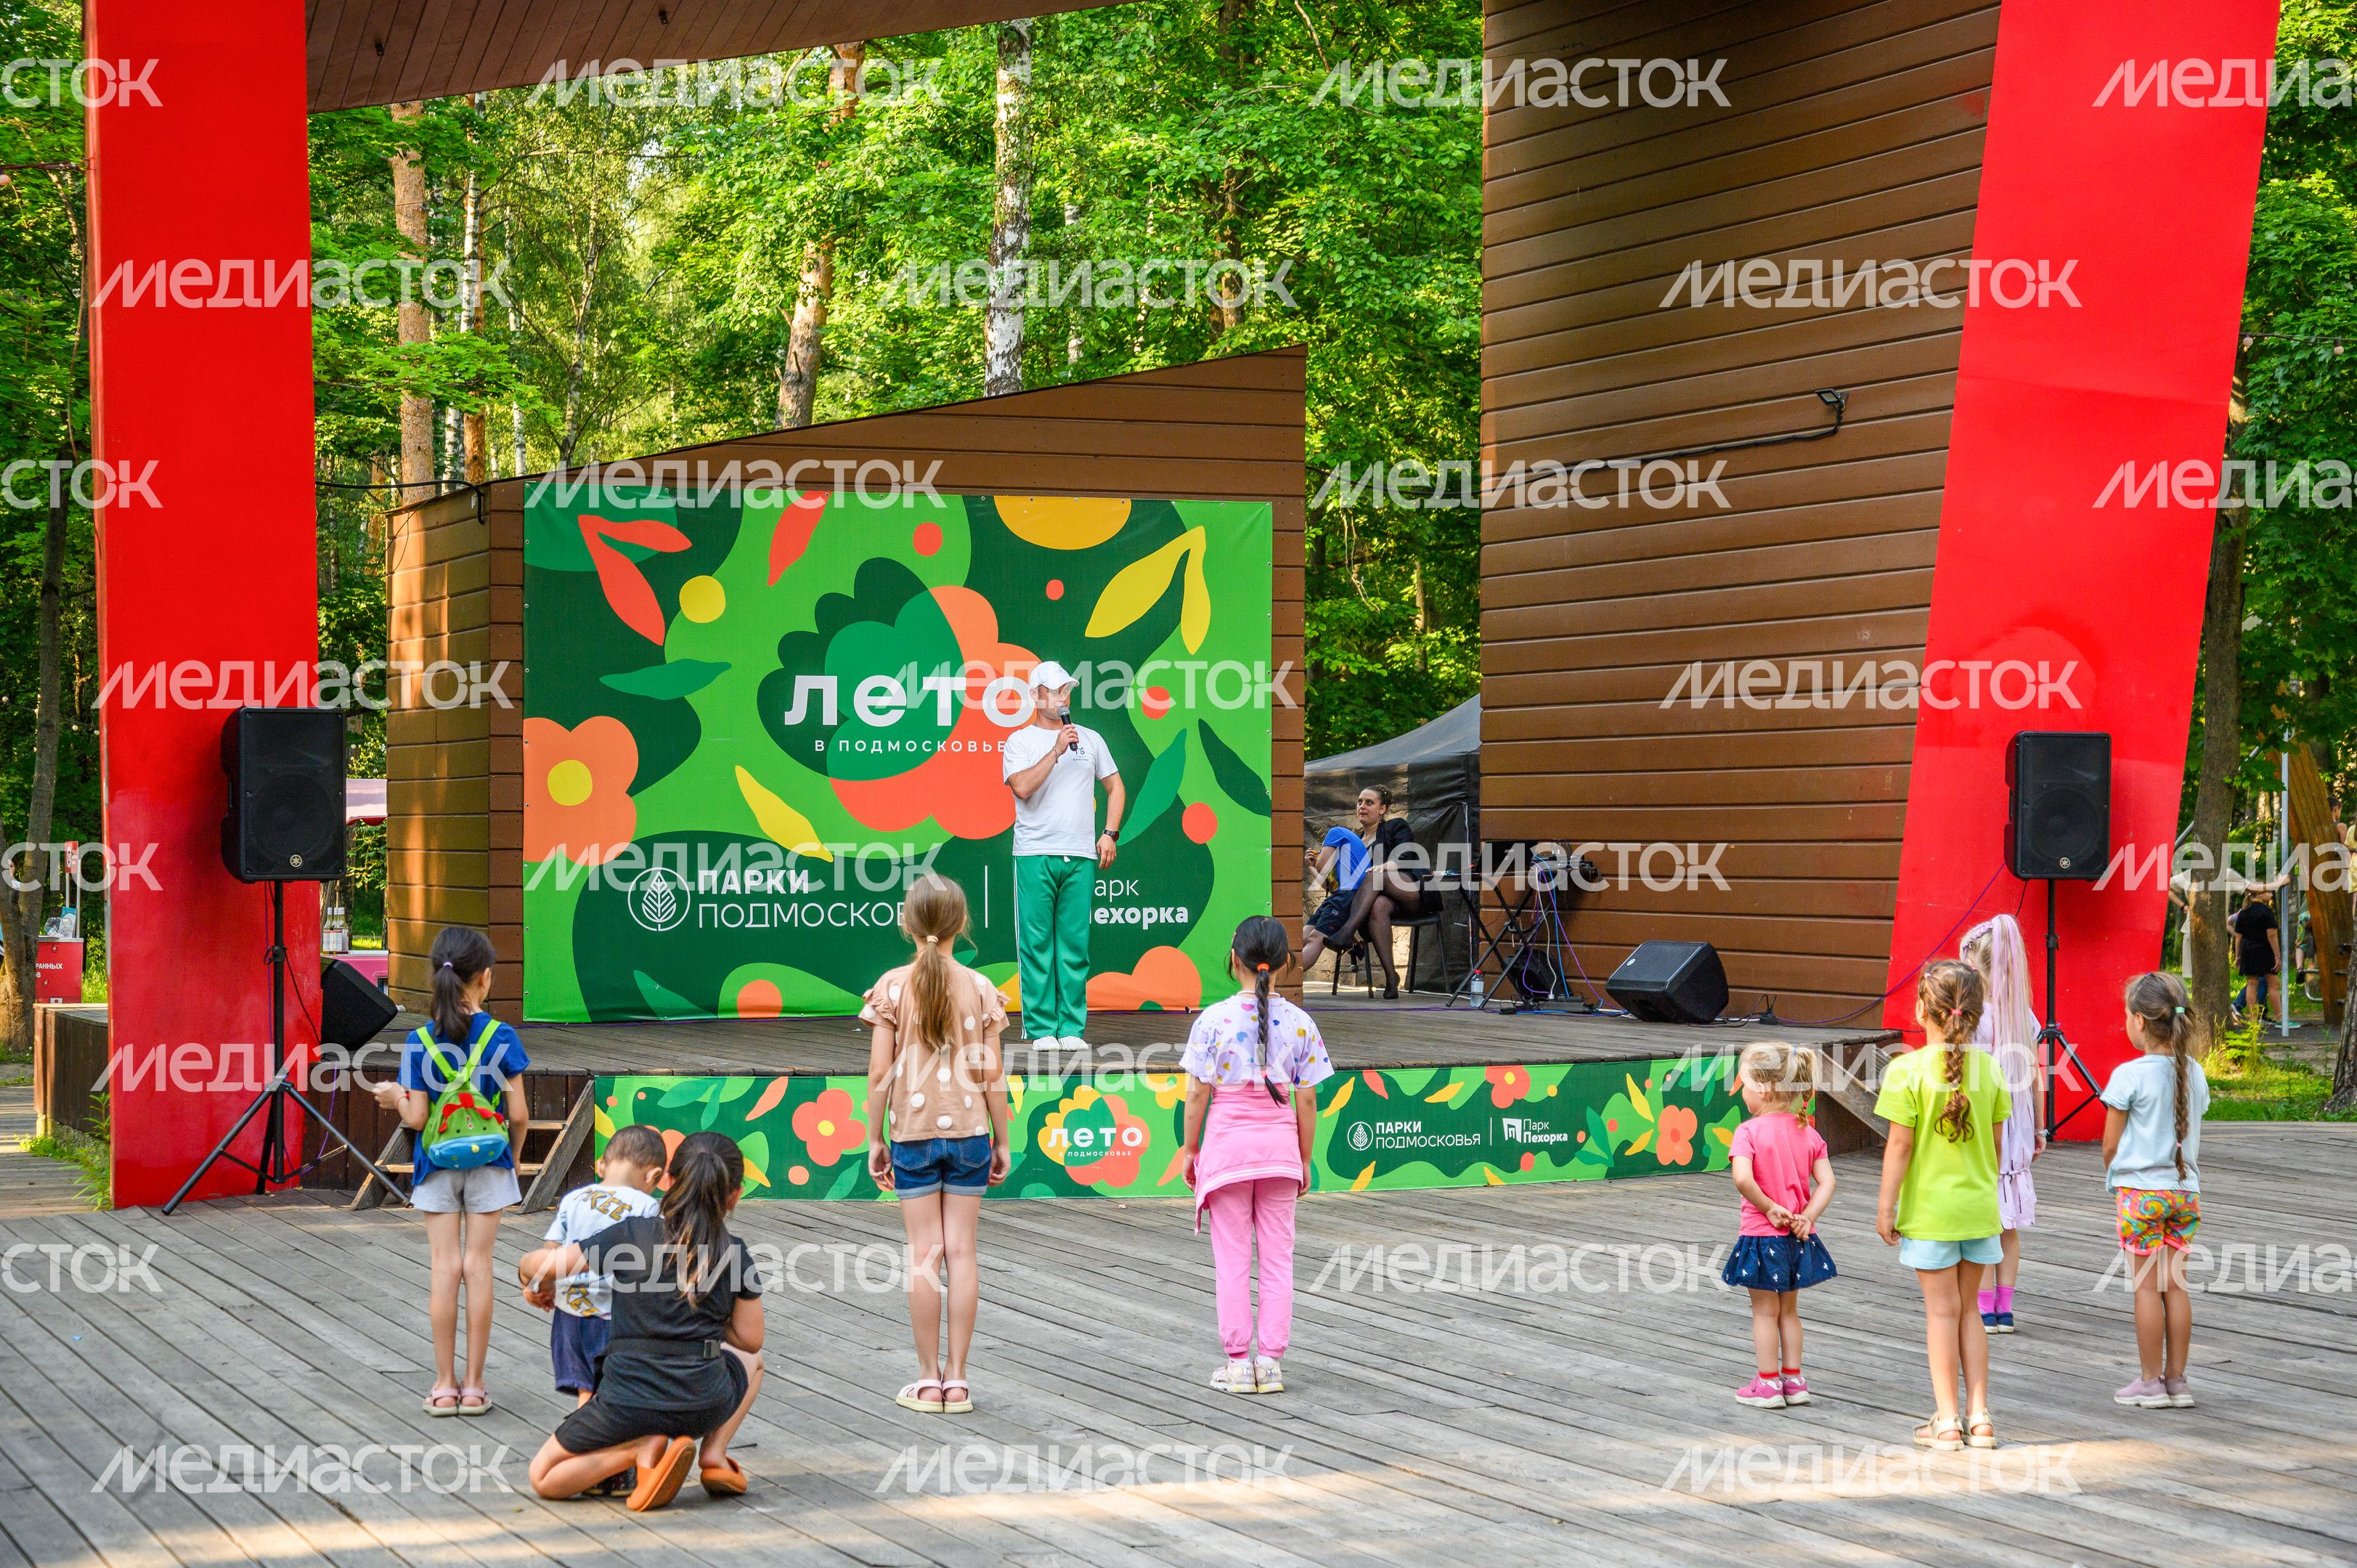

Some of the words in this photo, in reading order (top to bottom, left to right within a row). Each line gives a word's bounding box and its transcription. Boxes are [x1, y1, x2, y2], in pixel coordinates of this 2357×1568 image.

[815, 740, 825, 752] В
[839, 740, 1006, 754] ПОДМОСКОВЬЕ
[699, 869, 809, 894] ПАРКИ
[1094, 878, 1139, 903] арк
[1089, 906, 1189, 930] ехорка
[1376, 1121, 1422, 1134] ПАРКИ
[1523, 1119, 1550, 1132] Парк
[1376, 1133, 1481, 1149] ПОДМОСКОВЬЯ
[1523, 1131, 1568, 1146] Пехорка
